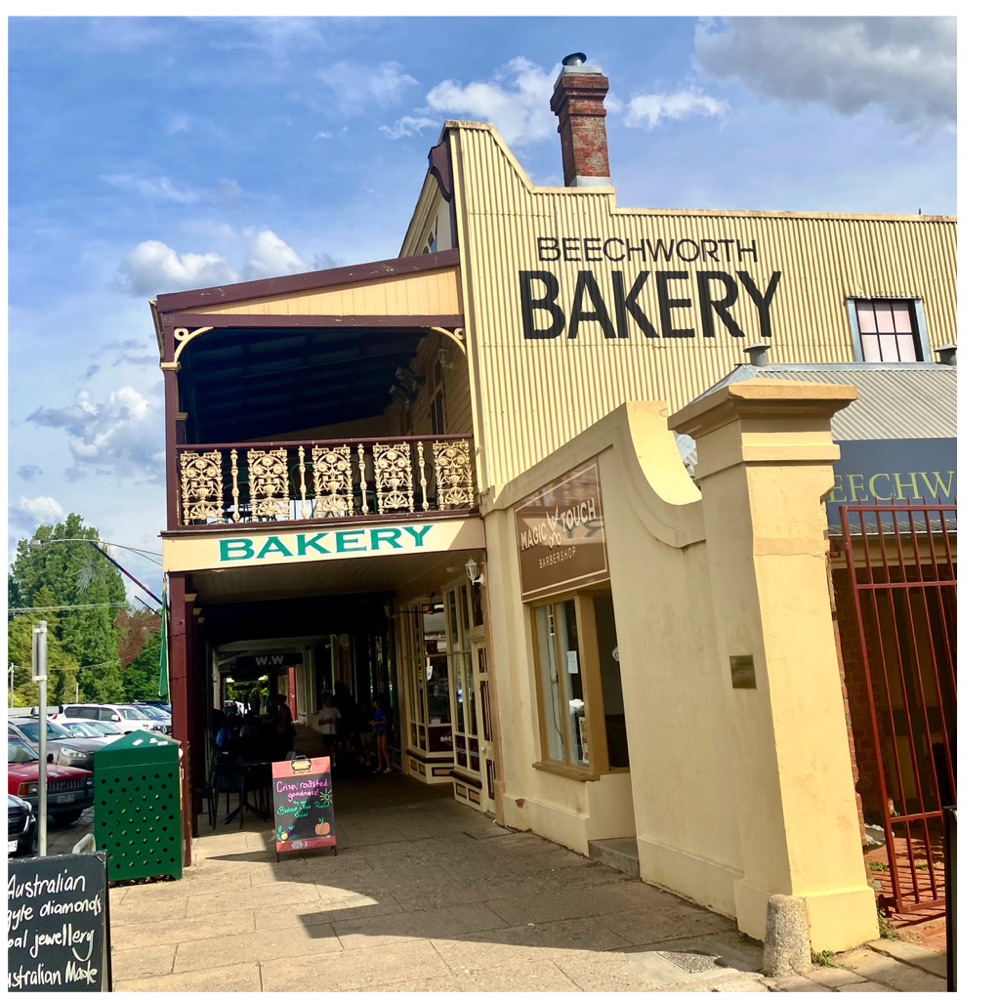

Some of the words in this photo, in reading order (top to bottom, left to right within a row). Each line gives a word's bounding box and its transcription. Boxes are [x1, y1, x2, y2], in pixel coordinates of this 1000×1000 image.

[536, 236, 758, 263] BEECHWORTH
[518, 270, 782, 339] BAKERY
[520, 521, 548, 551] MAGIC
[560, 498, 597, 532] TOUCH
[219, 525, 434, 562] BAKERY
[539, 546, 577, 568] BARBERSHOP
[8, 869, 86, 900] Australian
[40, 894, 102, 917] diamonds
[29, 923, 95, 962] jewellery
